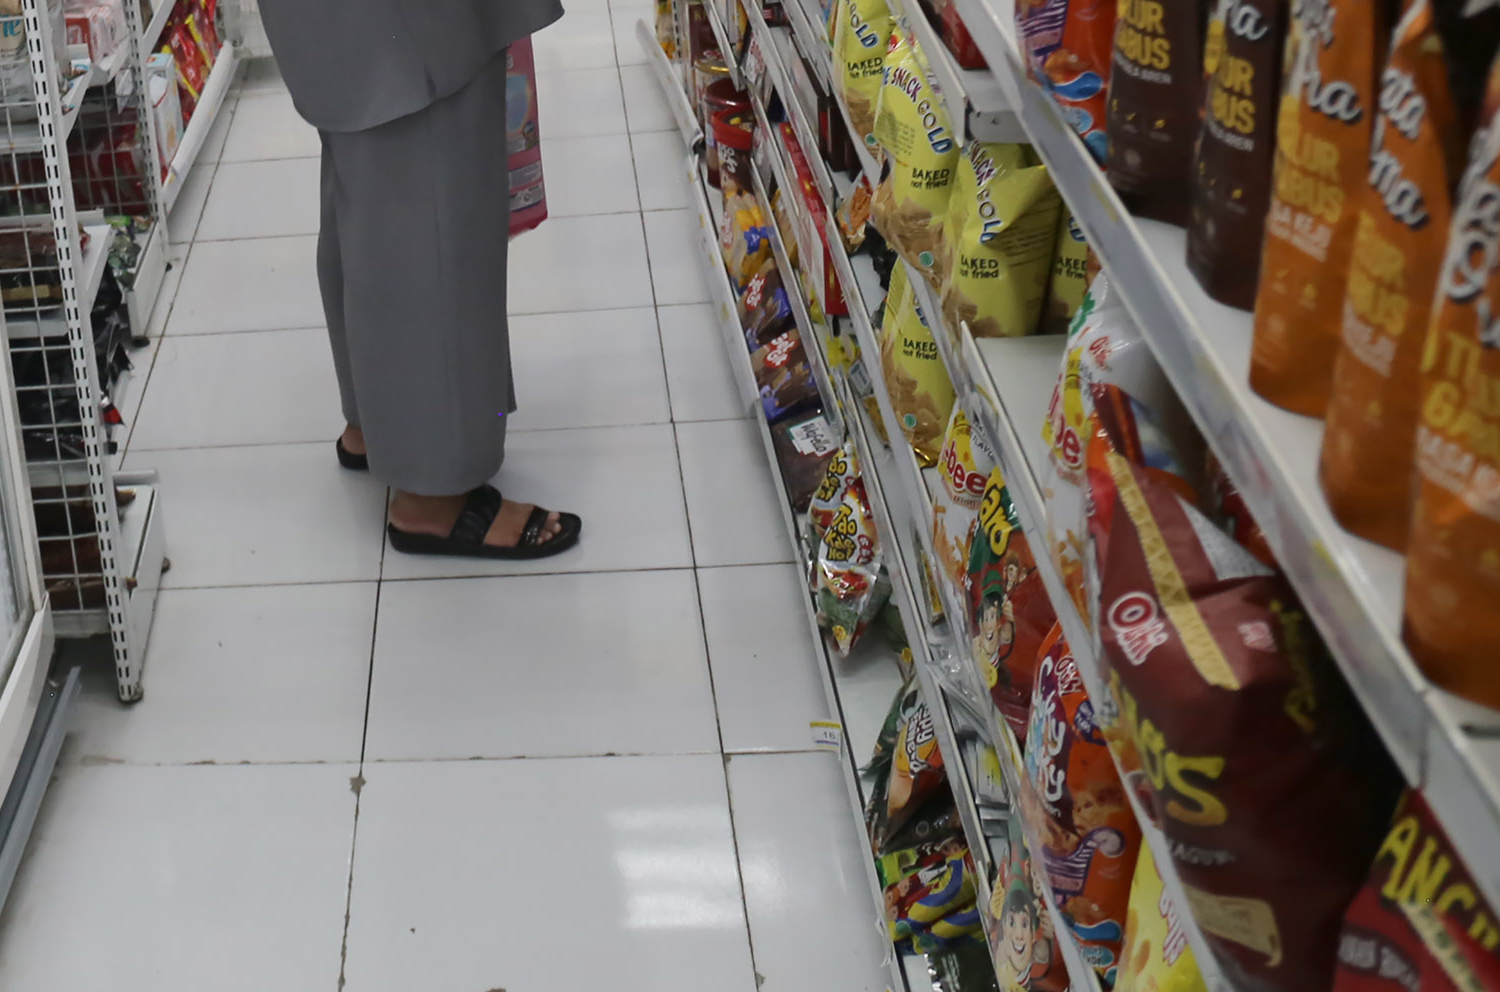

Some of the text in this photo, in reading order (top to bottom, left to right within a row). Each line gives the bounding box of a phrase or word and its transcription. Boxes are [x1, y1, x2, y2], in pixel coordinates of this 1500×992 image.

[890, 66, 954, 156] SNACK GOLD
[912, 167, 950, 181] BAKED
[924, 176, 949, 190] fried
[972, 267, 999, 279] fried
[915, 348, 938, 360] fried
